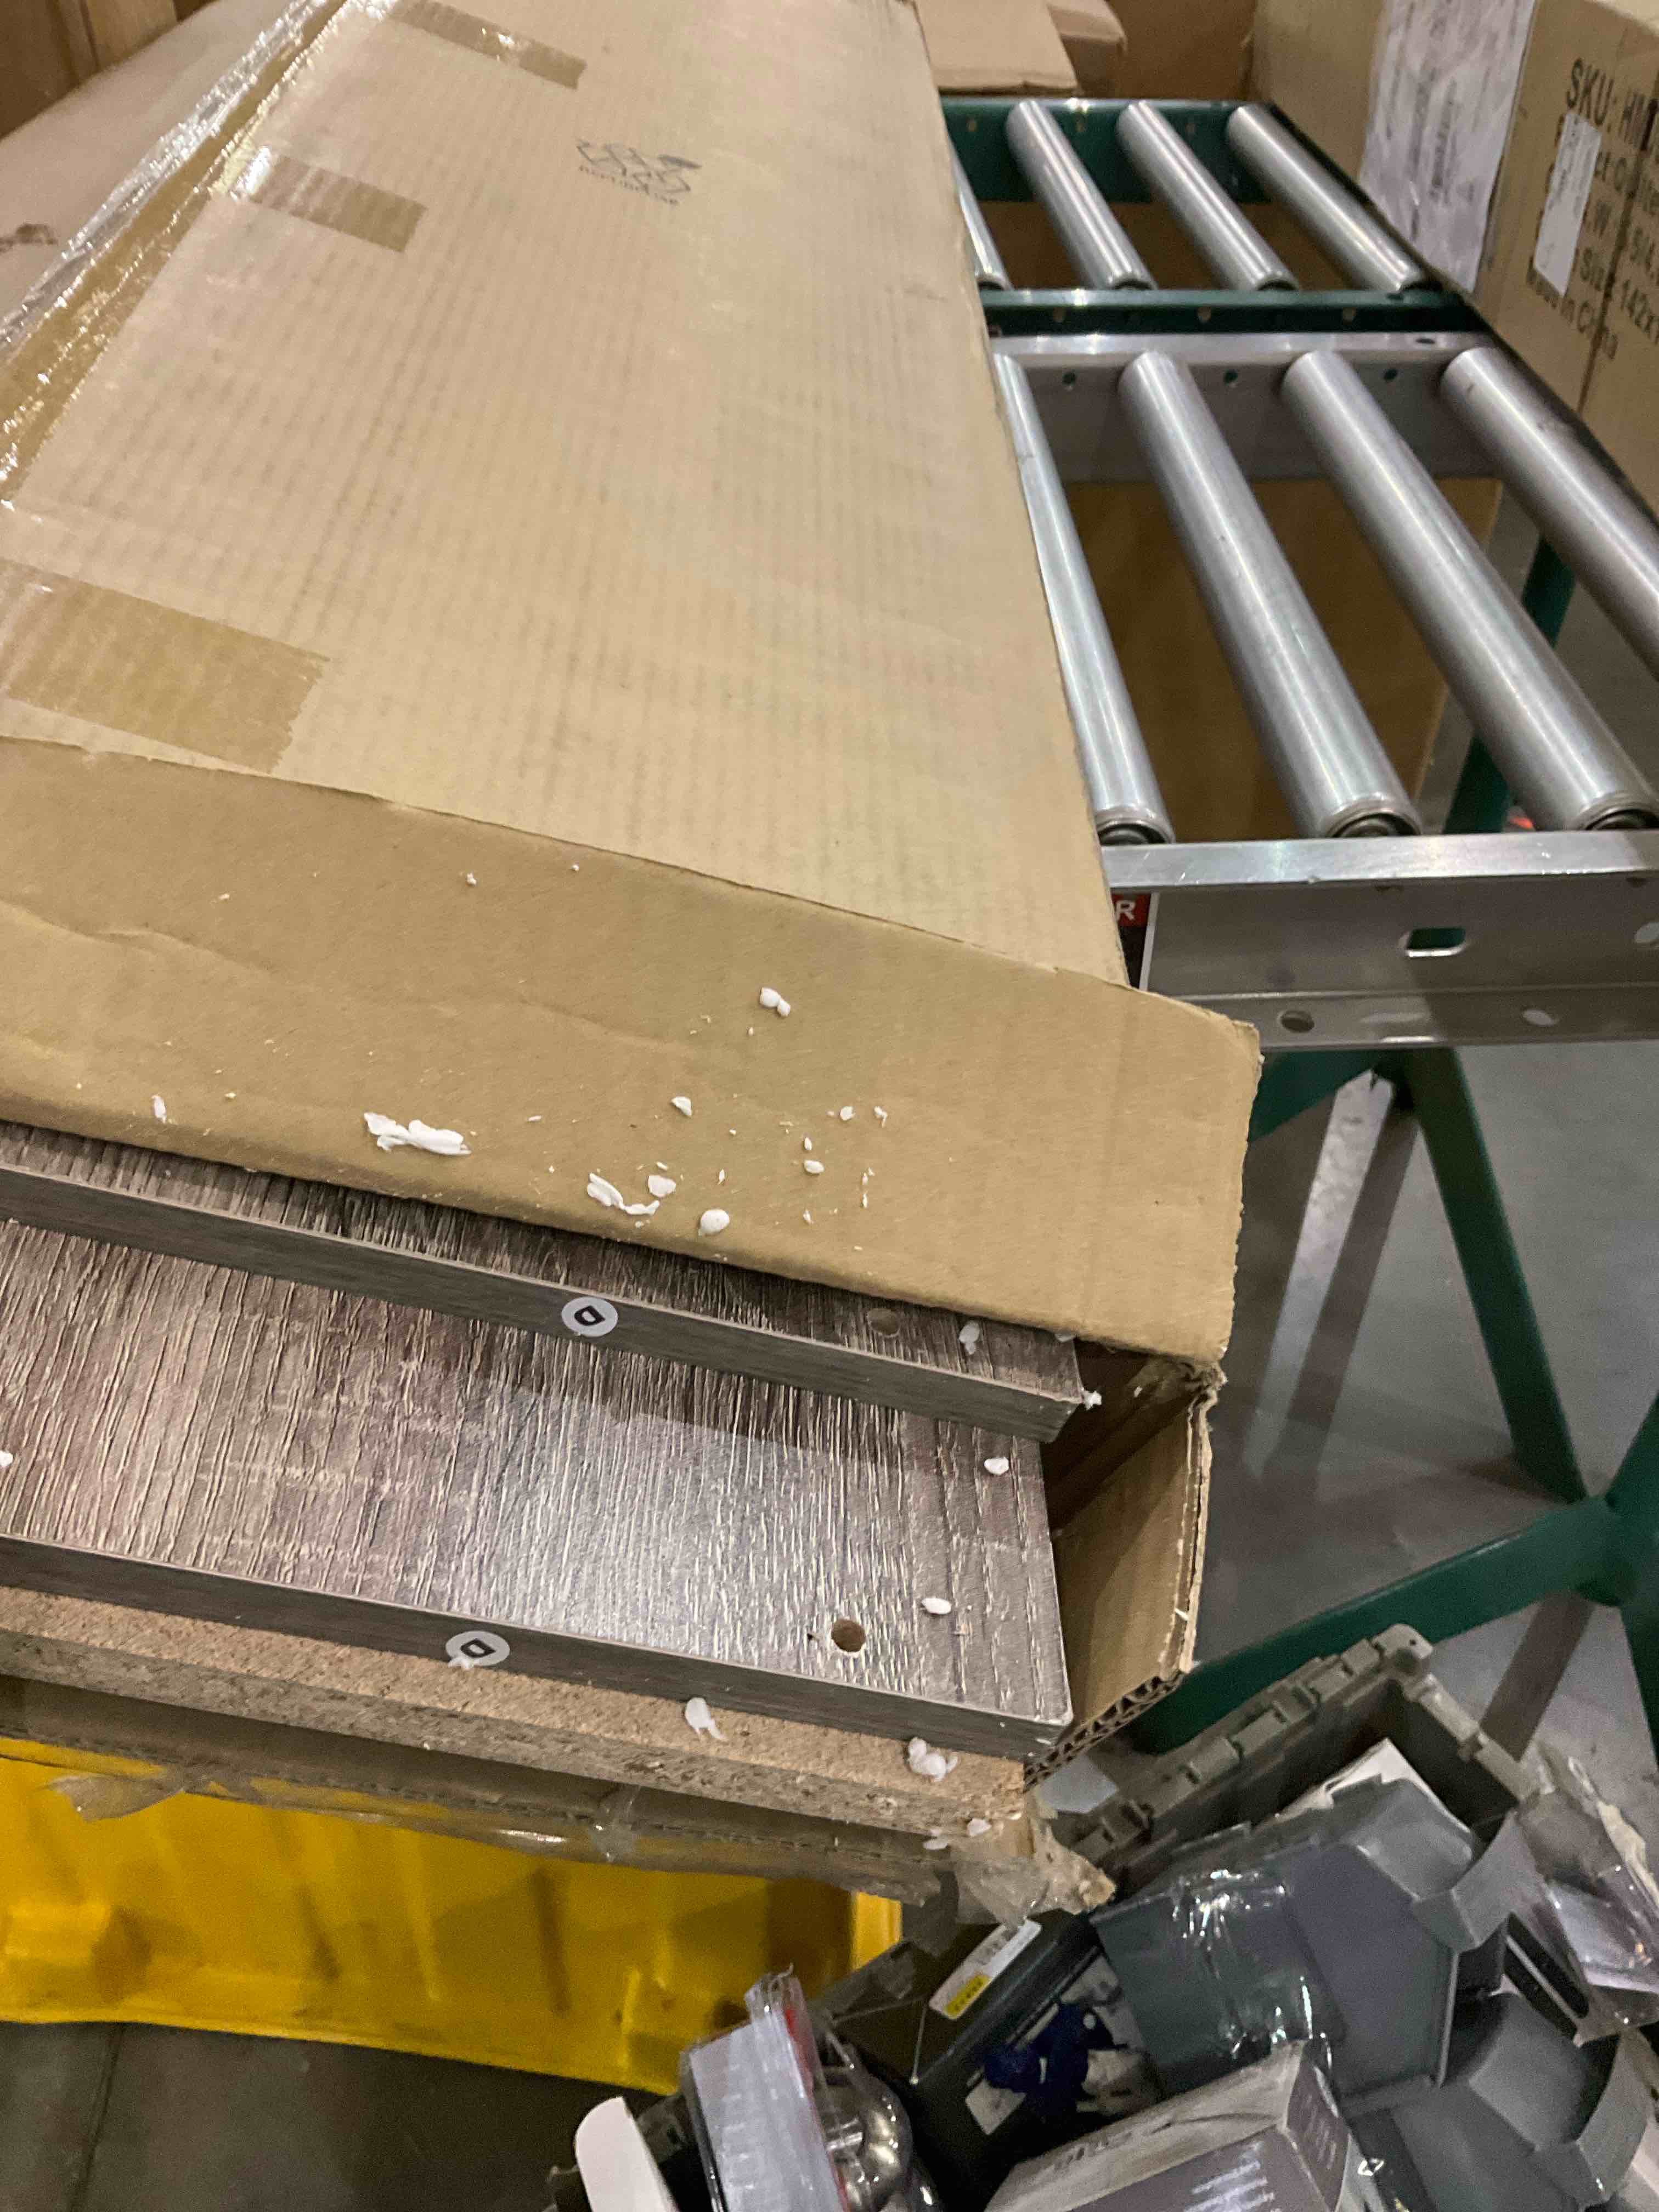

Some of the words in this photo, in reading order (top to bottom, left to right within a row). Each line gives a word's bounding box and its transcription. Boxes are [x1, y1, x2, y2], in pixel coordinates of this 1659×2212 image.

[1566, 57, 1617, 134] SKU:
[574, 1305, 606, 1327] D
[460, 1638, 496, 1658] D
